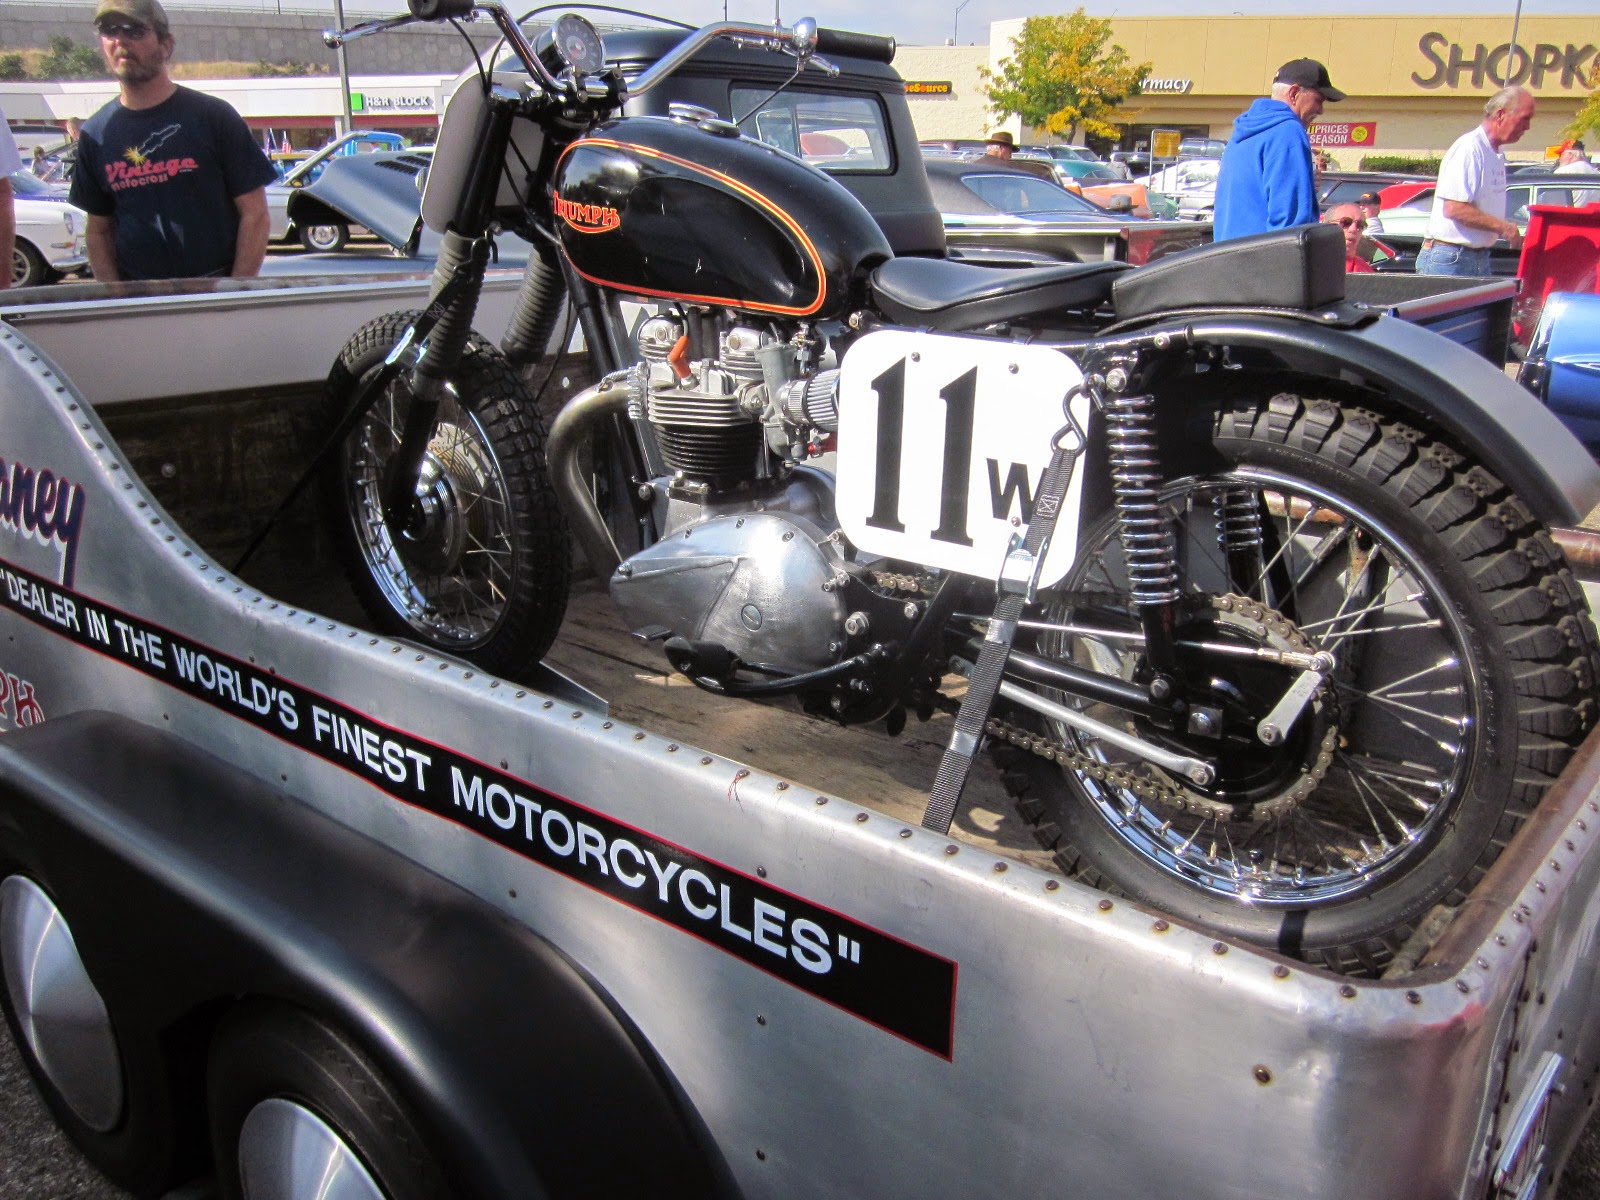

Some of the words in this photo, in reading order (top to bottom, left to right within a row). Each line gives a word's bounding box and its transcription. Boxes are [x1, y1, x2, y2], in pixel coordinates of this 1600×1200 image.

[1411, 31, 1600, 90] SHOPK
[1138, 78, 1191, 93] rmacy
[366, 97, 390, 106] H&R
[394, 96, 429, 106] BLOCK
[1315, 124, 1349, 134] PRICES
[1310, 135, 1348, 144] SEASON
[865, 356, 978, 548] 11
[85, 606, 111, 646] IN
[114, 619, 167, 670] THE
[171, 642, 300, 731] WORLD'S
[312, 705, 432, 792] FINEST
